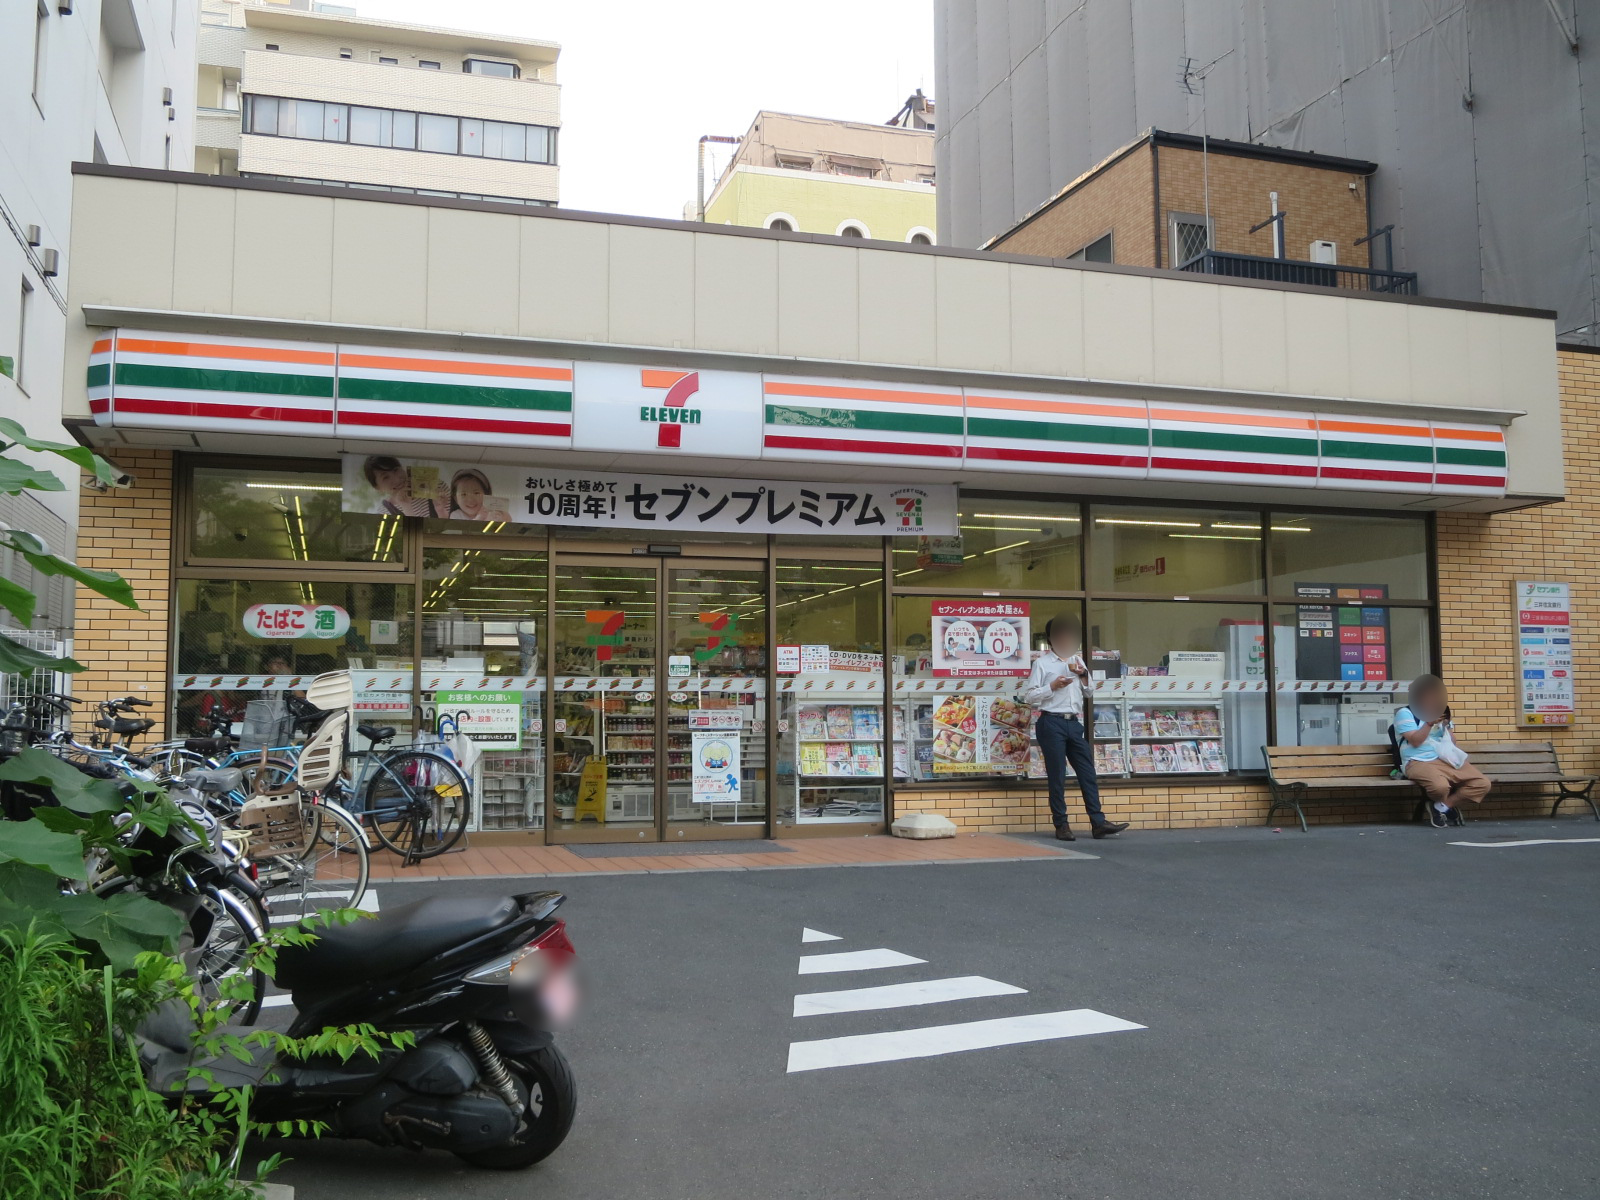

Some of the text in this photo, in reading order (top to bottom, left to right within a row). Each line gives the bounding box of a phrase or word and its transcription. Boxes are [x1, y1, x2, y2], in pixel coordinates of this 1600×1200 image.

[525, 476, 618, 493] おいしさ極めて
[524, 491, 616, 519] 10周年!
[625, 482, 886, 528] セブンプレミアム
[257, 609, 336, 630] たばこ 酒
[448, 693, 511, 702] お客様へのお願い
[980, 697, 989, 762] こだわり特製弁当
